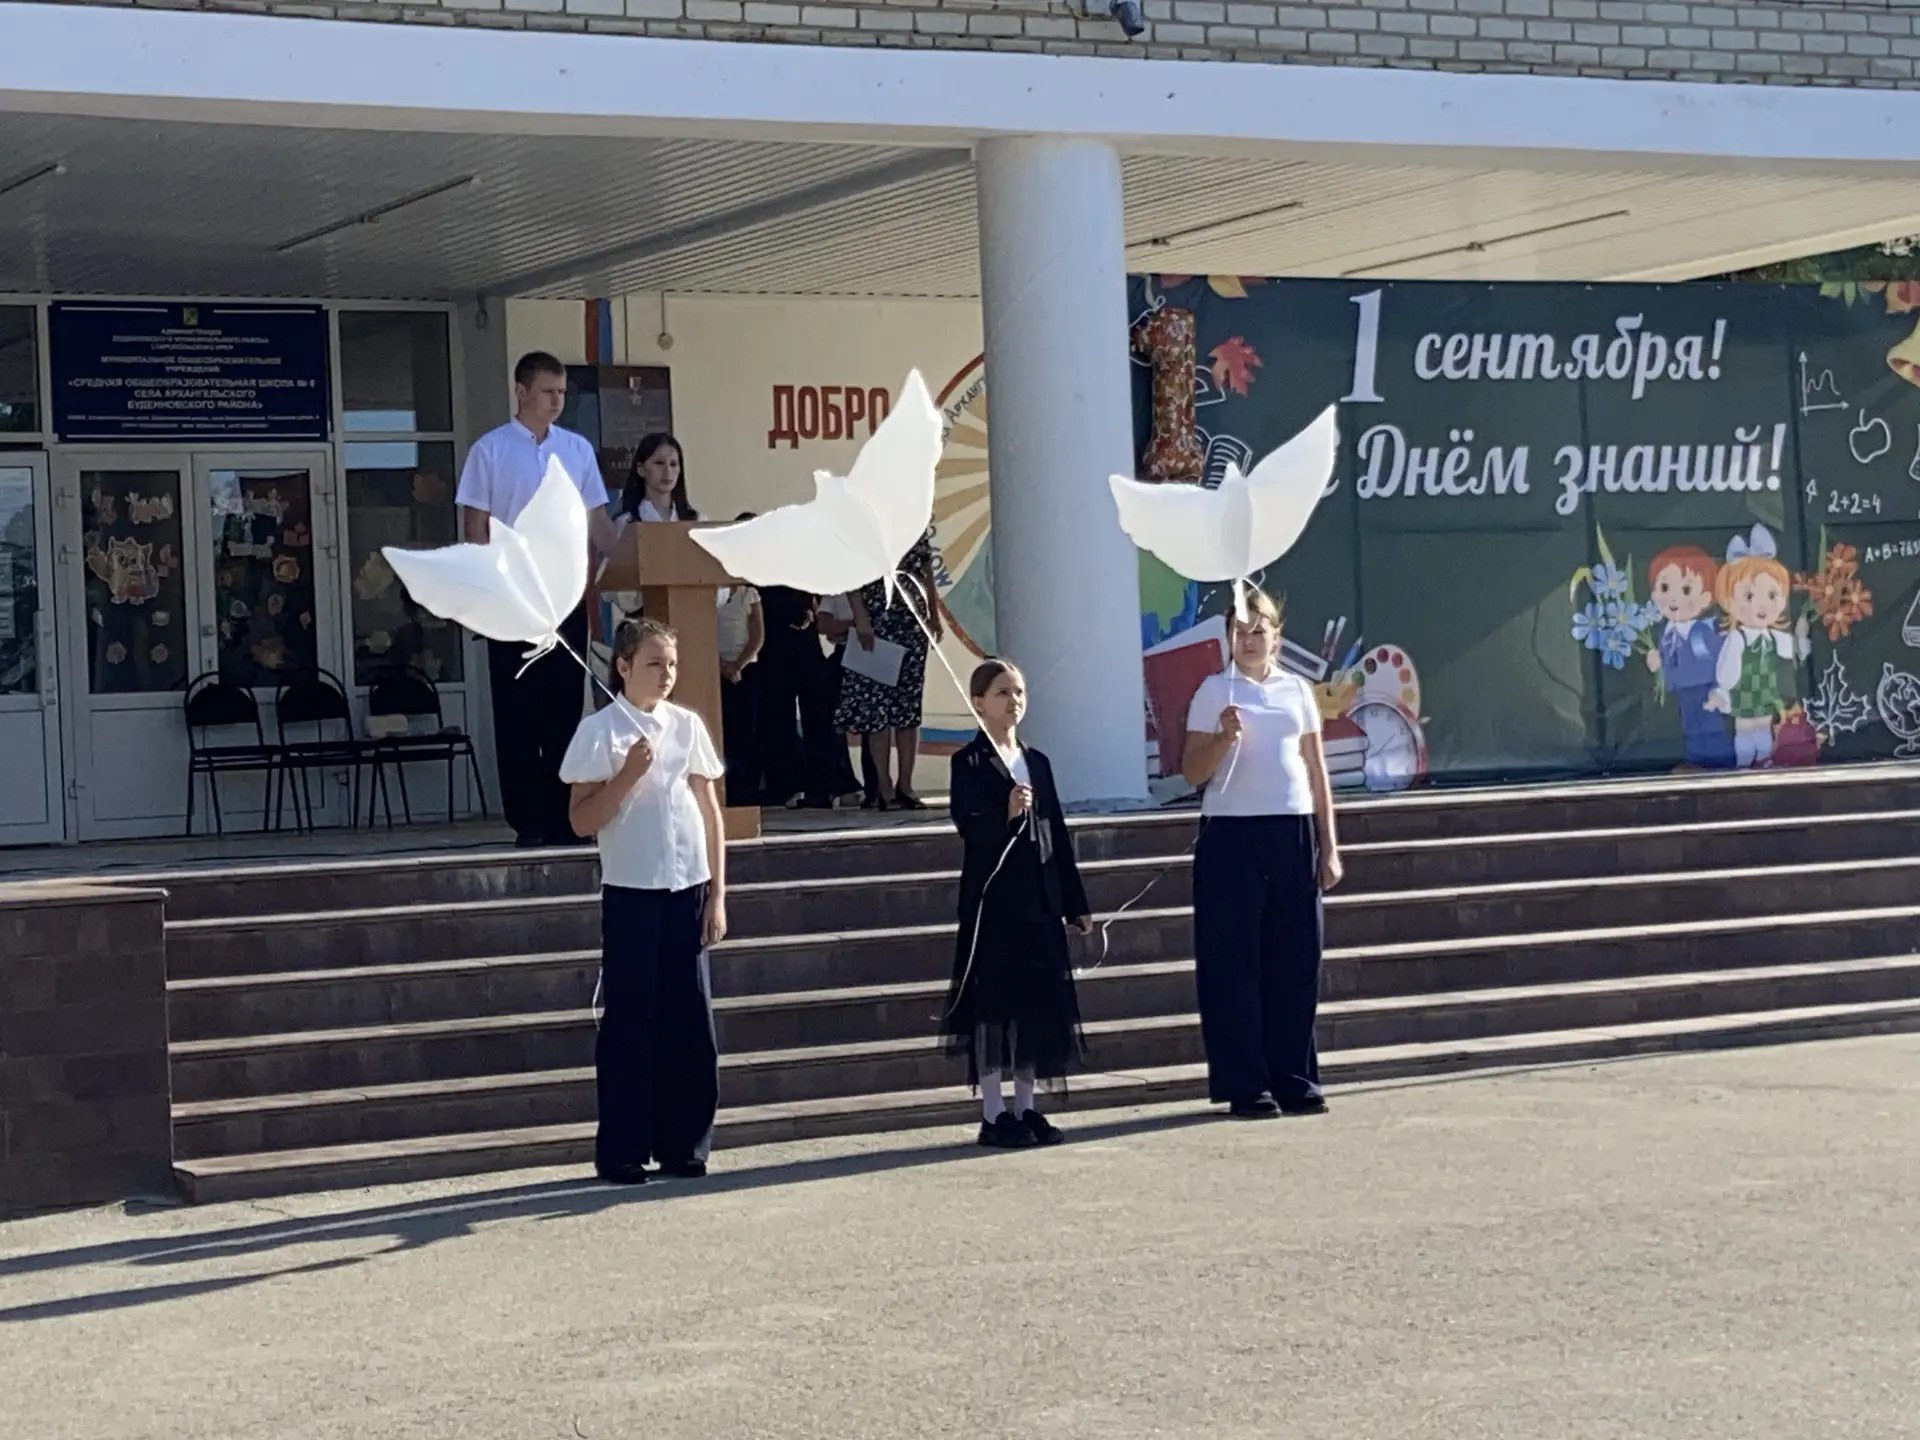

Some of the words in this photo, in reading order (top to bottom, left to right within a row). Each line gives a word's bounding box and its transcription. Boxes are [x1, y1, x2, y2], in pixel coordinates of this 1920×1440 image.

[1340, 289, 1384, 402] 1
[1413, 313, 1728, 400] сентября!
[768, 385, 889, 449] ДОБРО
[1356, 424, 1531, 499] Днём
[1553, 423, 1787, 515] знаний!
[1827, 489, 1881, 515] 2+2=4
